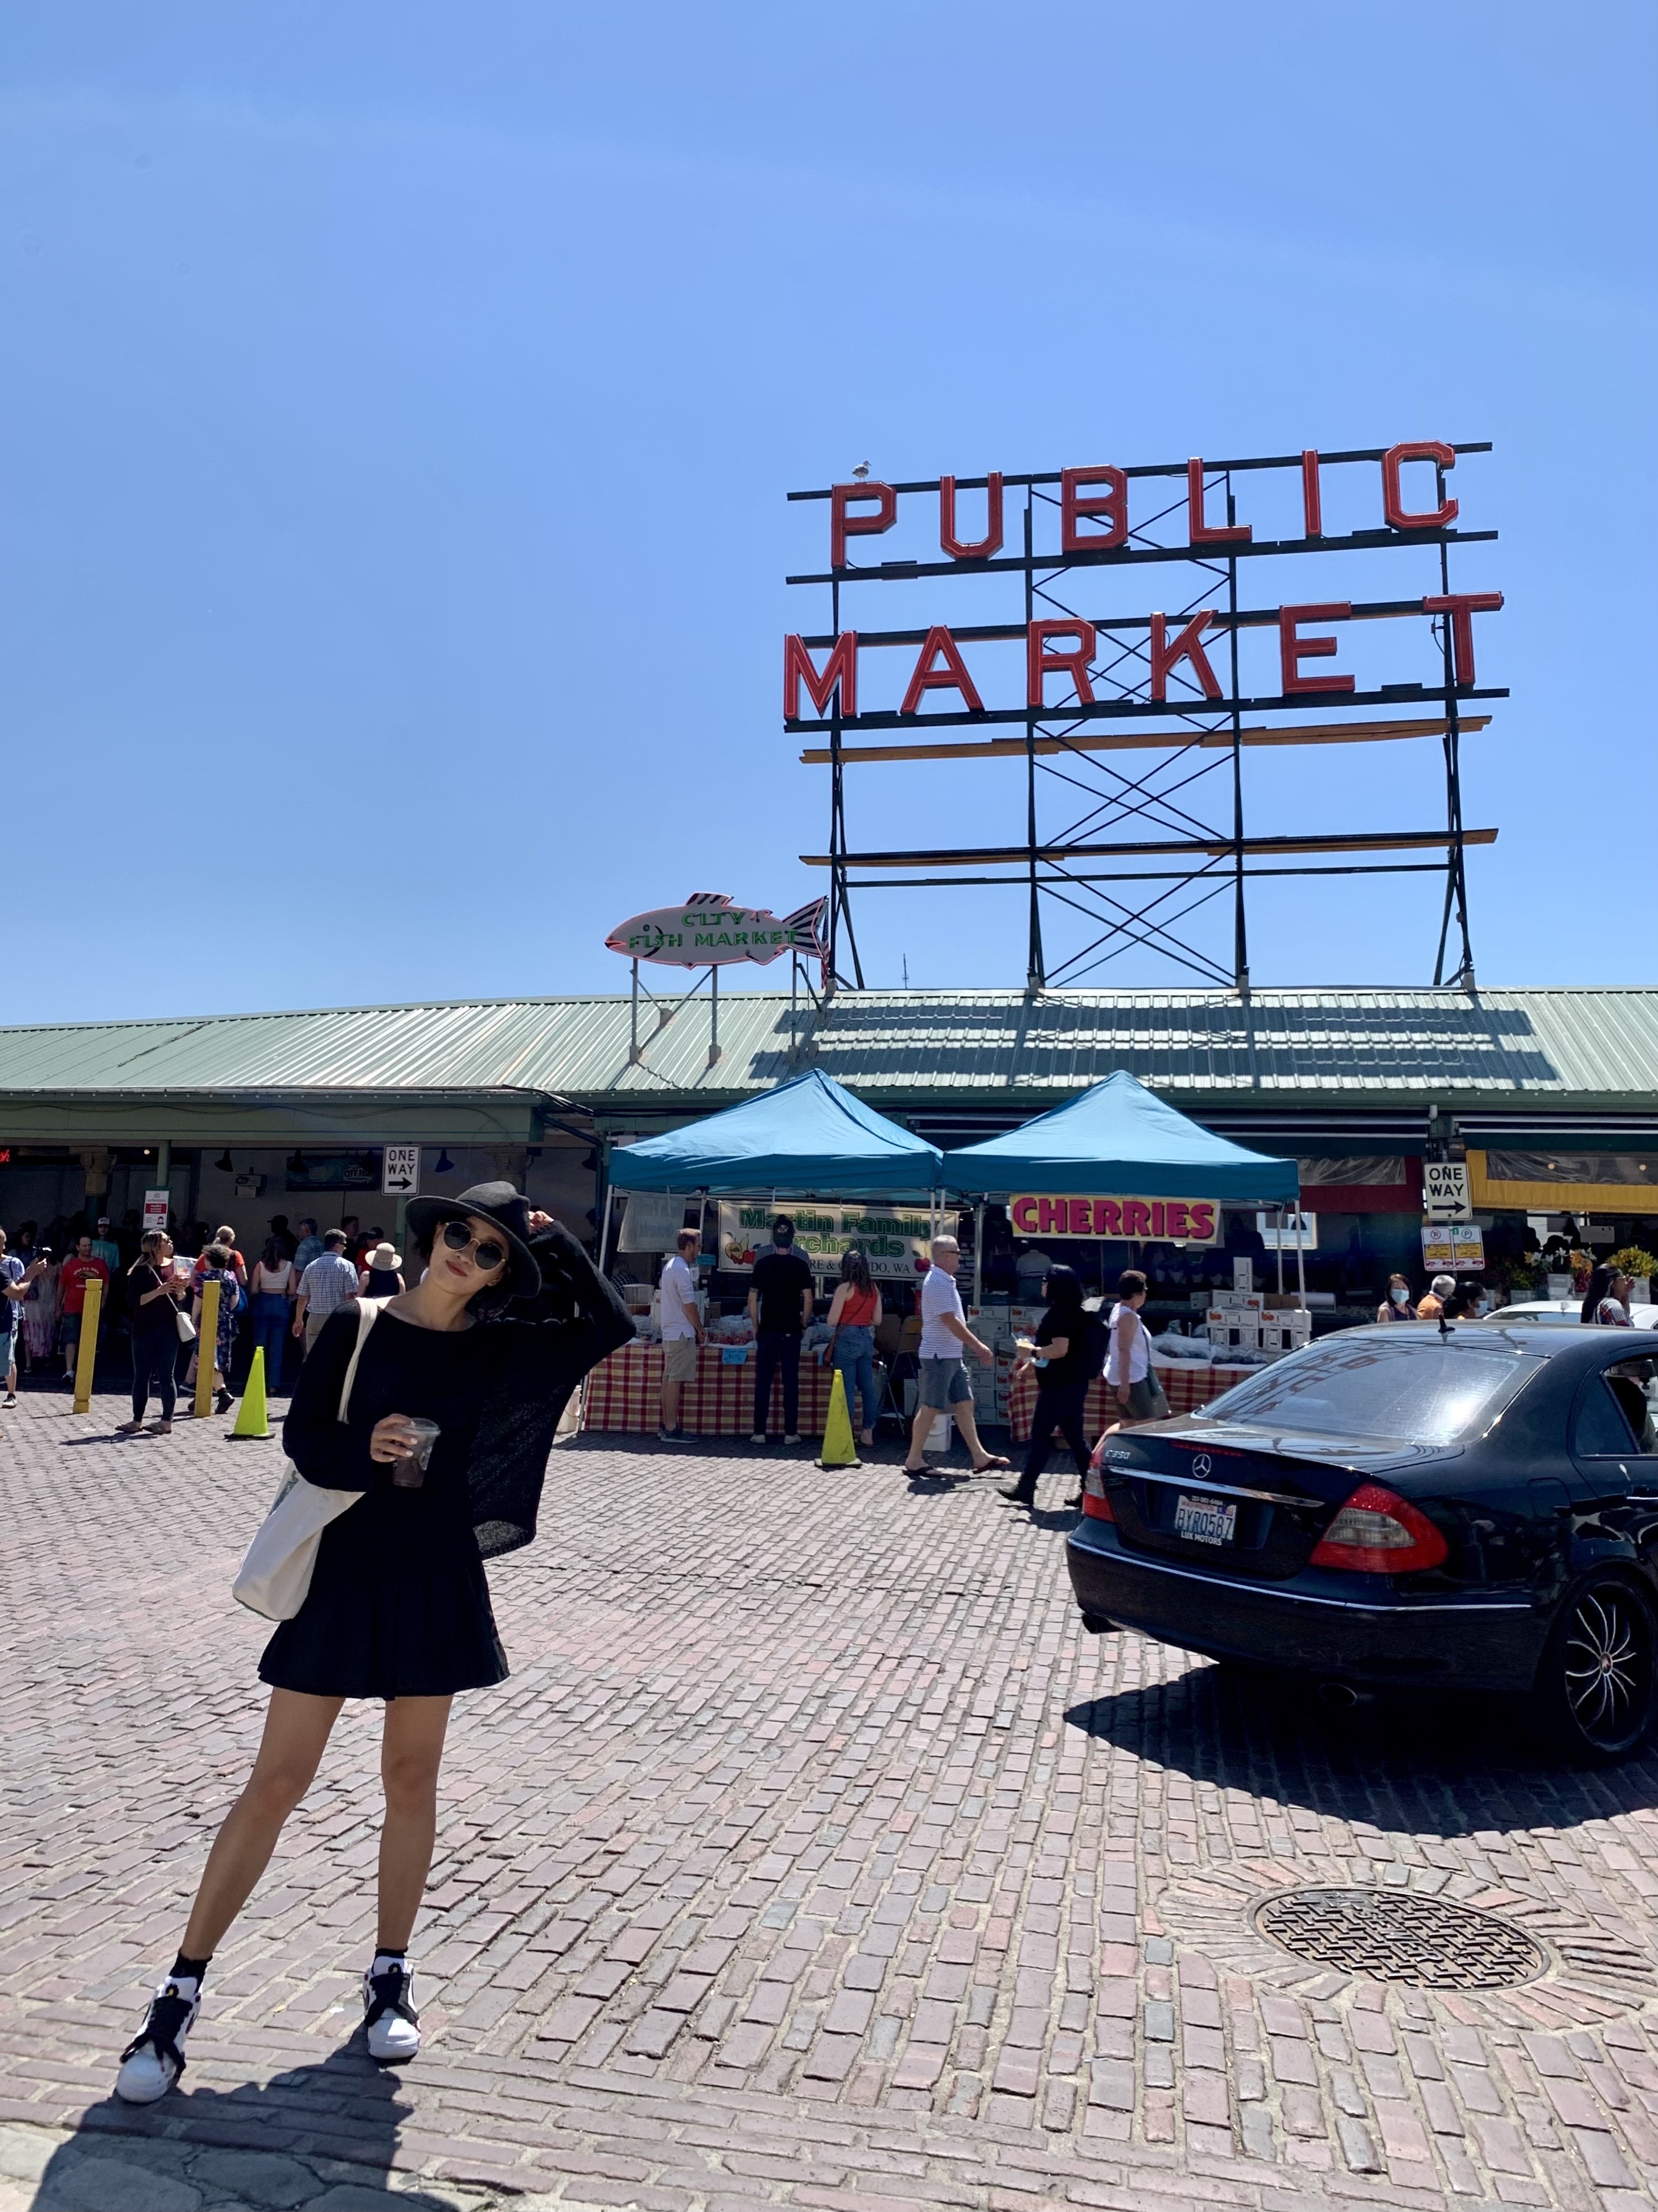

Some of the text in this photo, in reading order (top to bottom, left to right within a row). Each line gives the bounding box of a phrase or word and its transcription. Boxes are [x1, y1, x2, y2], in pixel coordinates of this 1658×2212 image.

[831, 439, 1458, 568] PUBLIC
[784, 591, 1503, 719] MARKET
[682, 912, 746, 927] CITY
[629, 929, 798, 949] FISH MARKET
[389, 1150, 415, 1161] ONE
[388, 1163, 415, 1175] WAY
[1429, 1167, 1463, 1180] ONE
[1429, 1184, 1464, 1197] WAY
[739, 1208, 834, 1232] Matin
[1013, 1197, 1214, 1239] CHERRIES
[771, 1233, 905, 1258] rchards
[826, 1261, 836, 1270] &
[894, 1263, 910, 1274] WA
[1105, 1449, 1131, 1459] E350
[1176, 1508, 1233, 1539] BYR0587
[1181, 1531, 1223, 1546] LUX MOTORS
